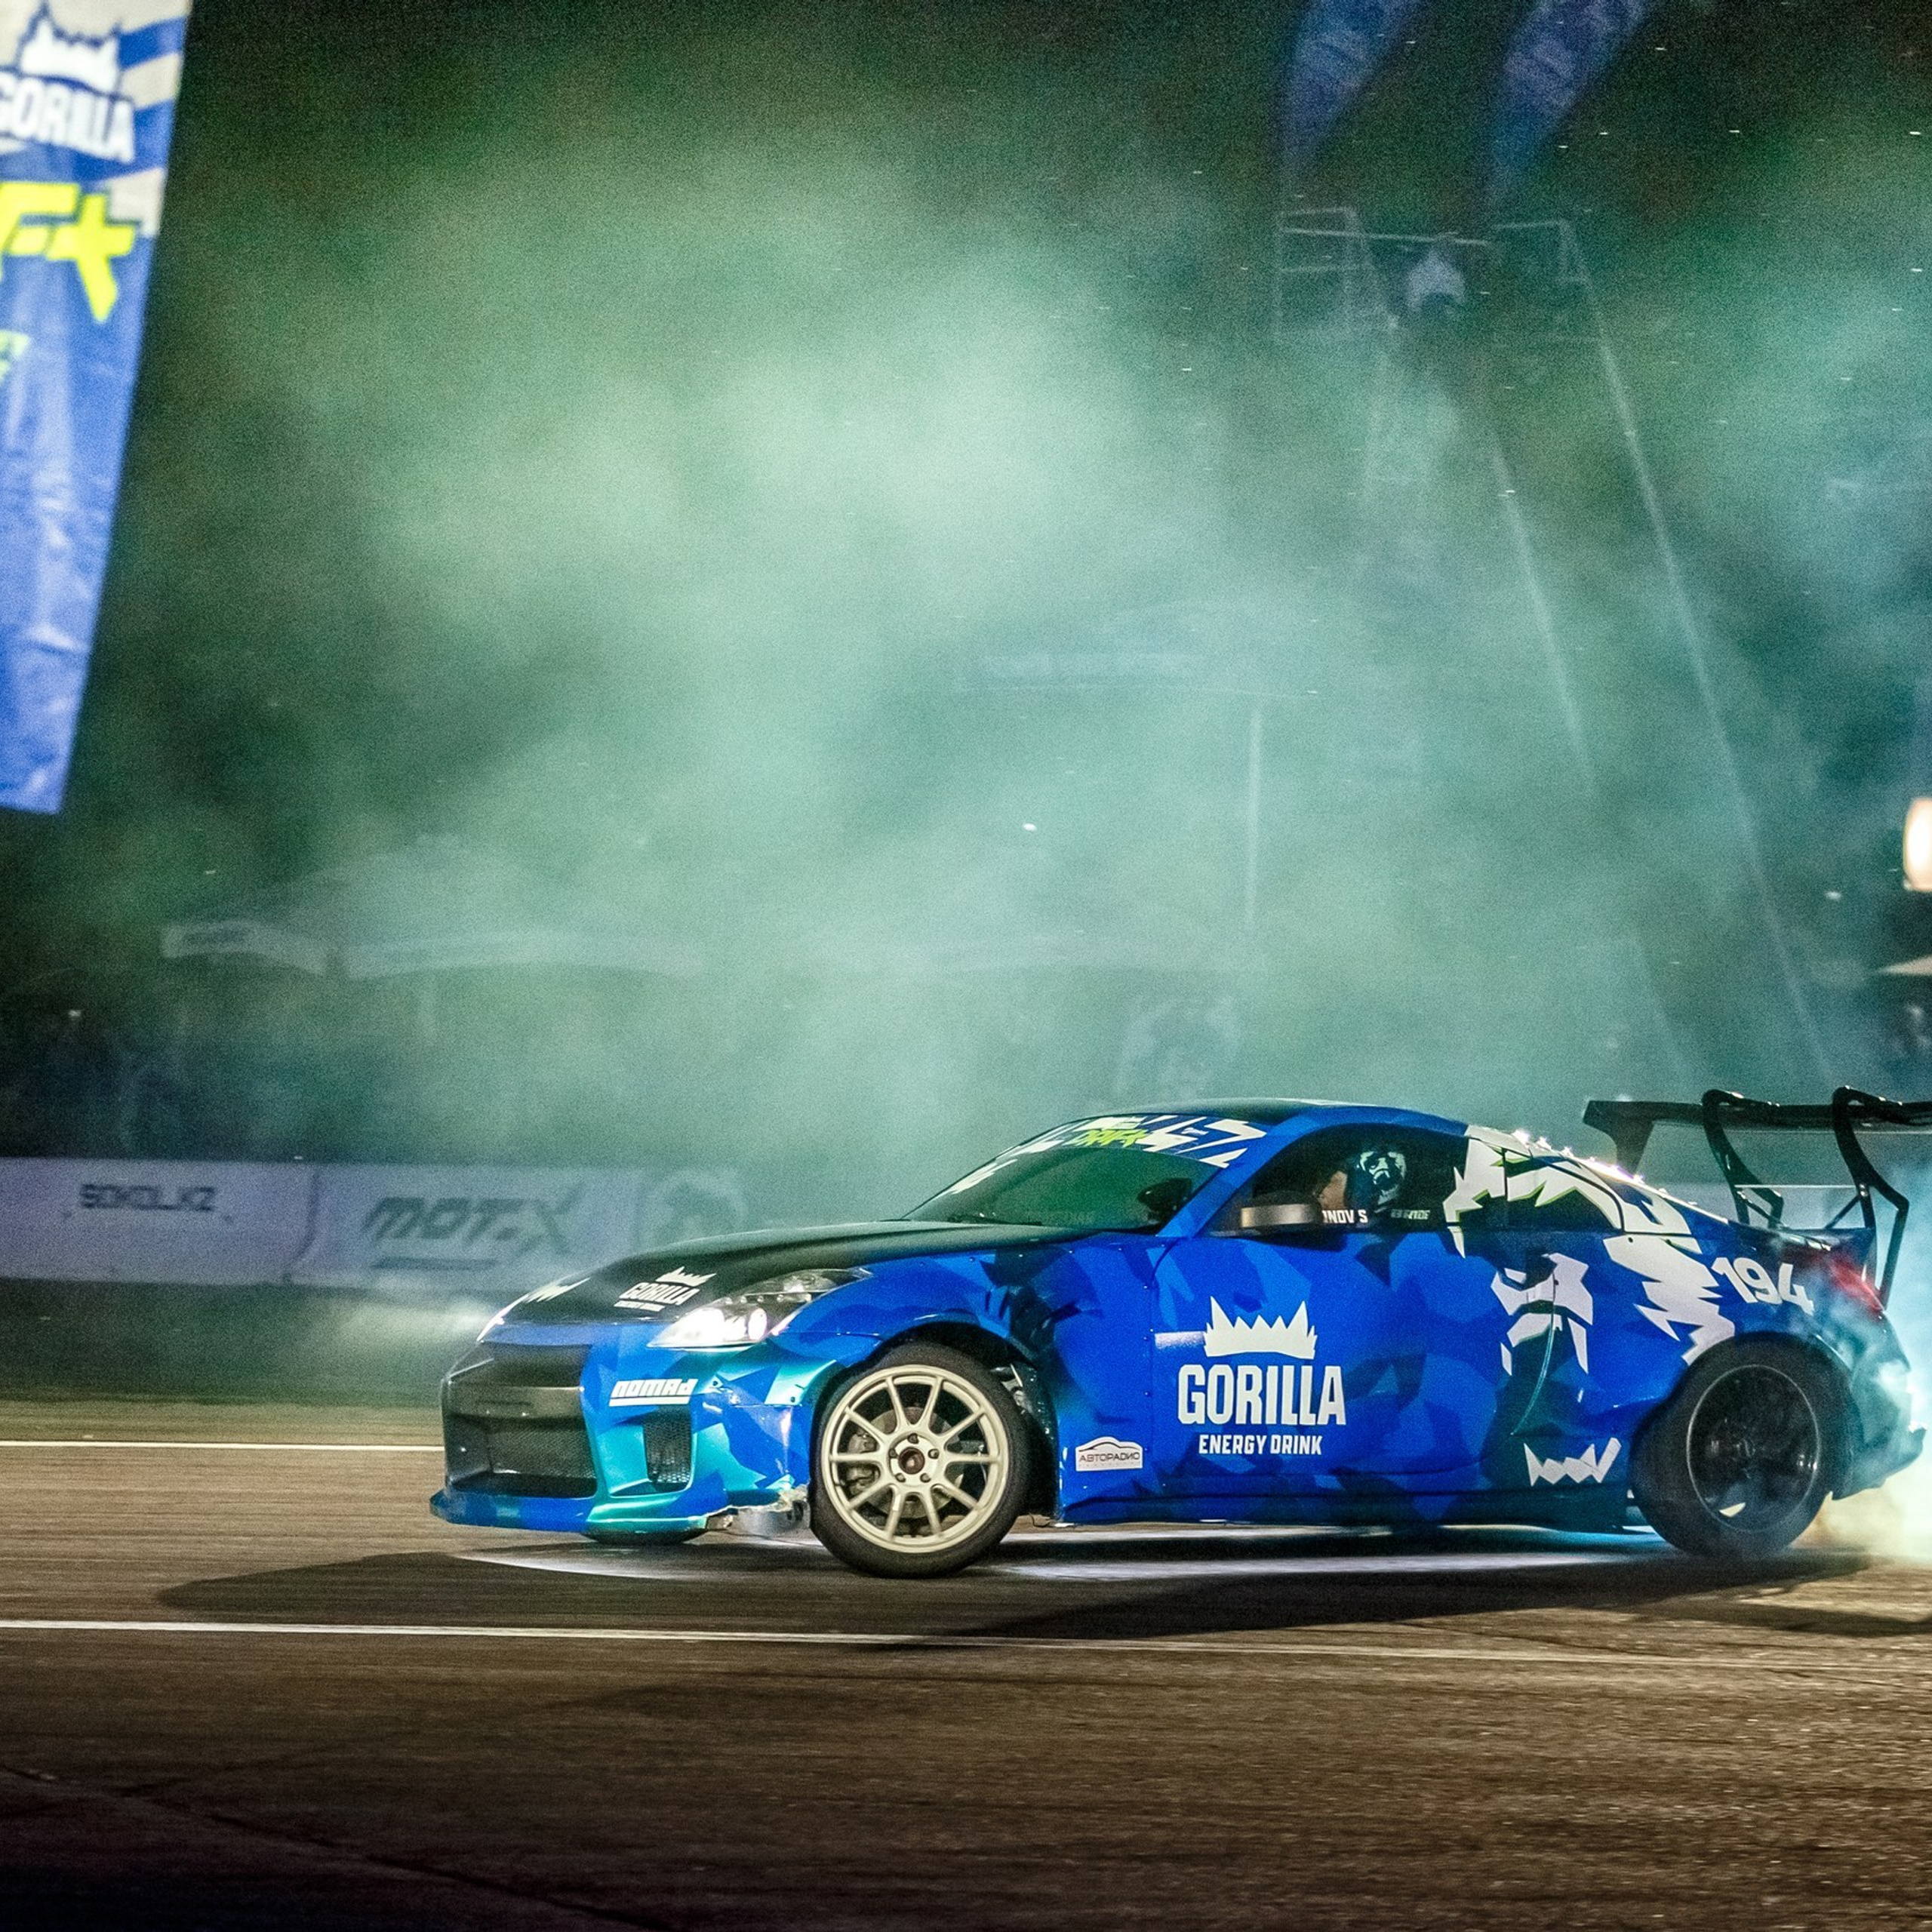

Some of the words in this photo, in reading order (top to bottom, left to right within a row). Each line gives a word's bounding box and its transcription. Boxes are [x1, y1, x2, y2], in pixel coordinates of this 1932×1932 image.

[1358, 1209, 1368, 1223] S
[619, 1282, 700, 1306] GORILLA
[1711, 1257, 1815, 1316] 194
[1177, 1364, 1346, 1426] GORILLA
[1198, 1434, 1267, 1455] ENERGY
[1269, 1434, 1323, 1455] DRINK
